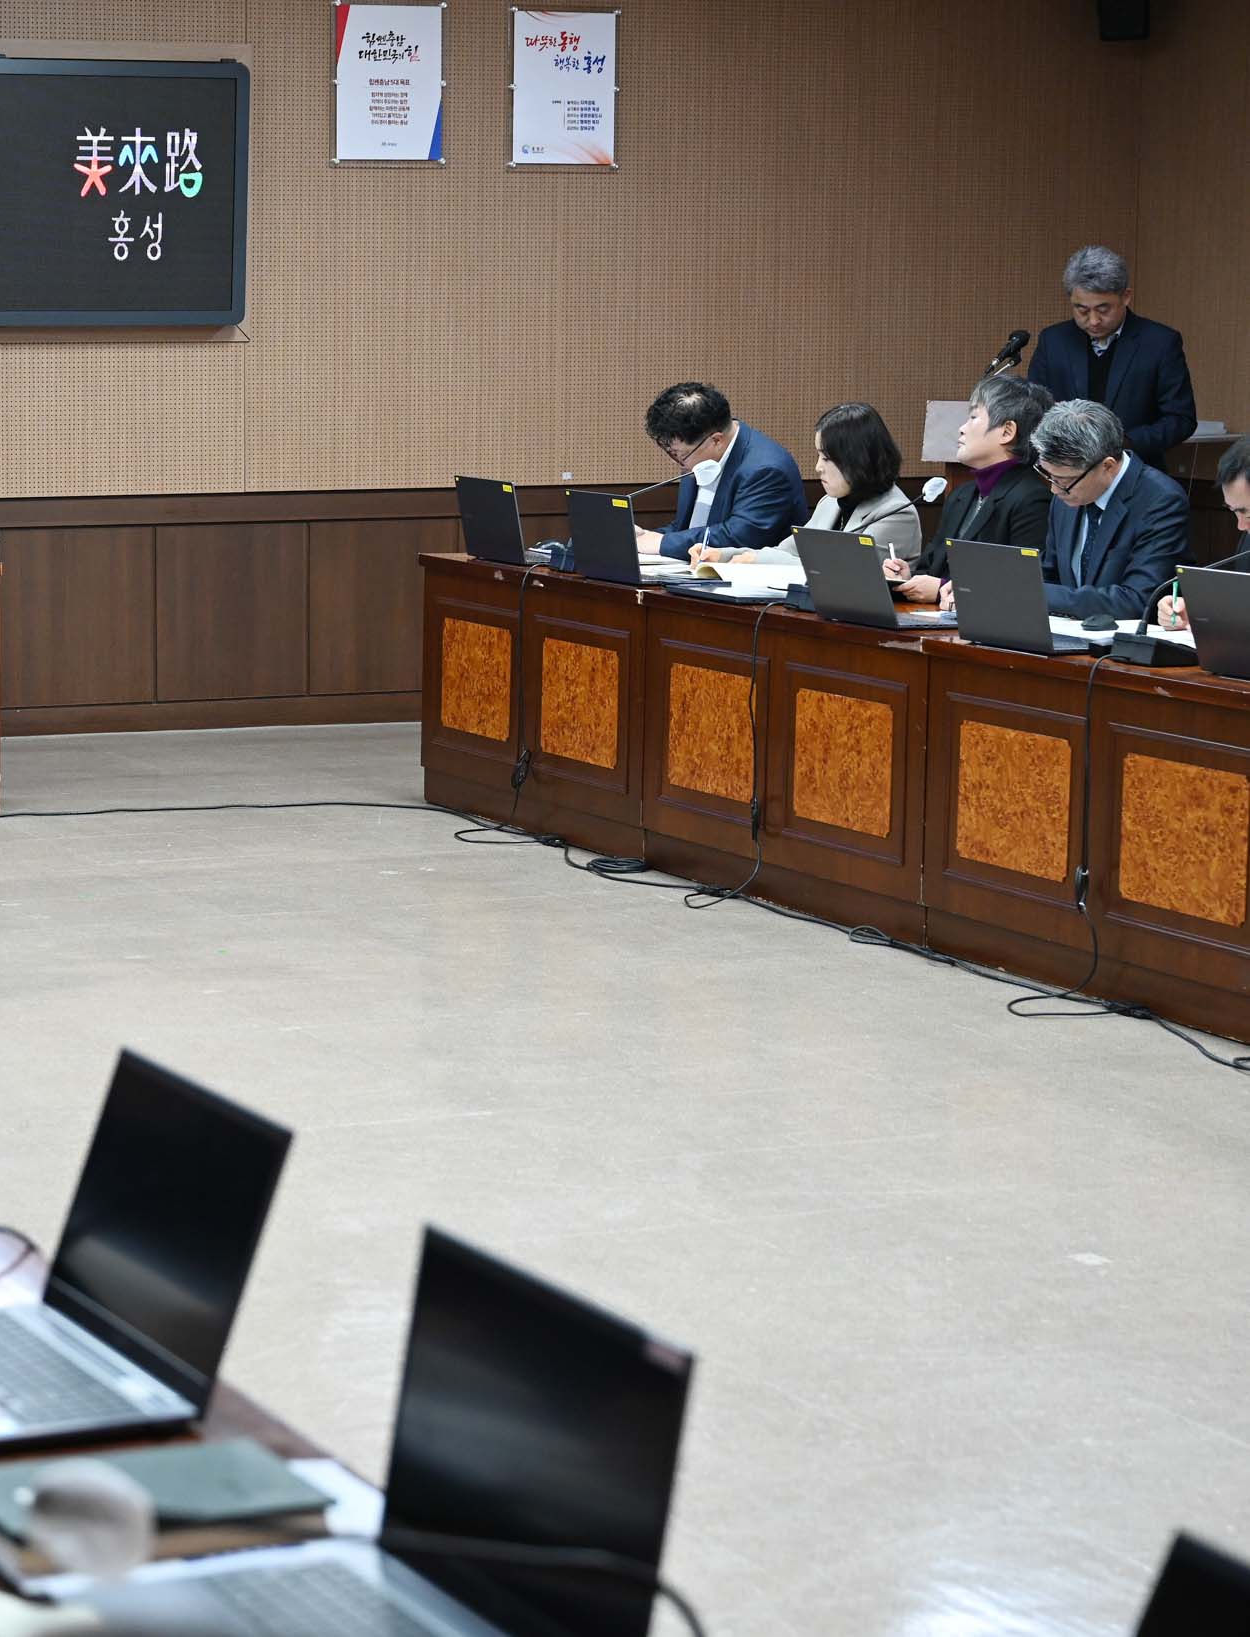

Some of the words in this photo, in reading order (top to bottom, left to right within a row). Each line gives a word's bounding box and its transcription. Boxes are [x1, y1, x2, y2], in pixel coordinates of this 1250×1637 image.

[525, 34, 557, 52] 따뜻한
[558, 31, 581, 52] 동행
[553, 54, 580, 72] 행복한
[583, 50, 606, 74] 홍성
[73, 126, 203, 198] 美來路
[108, 209, 163, 261] 홍성
